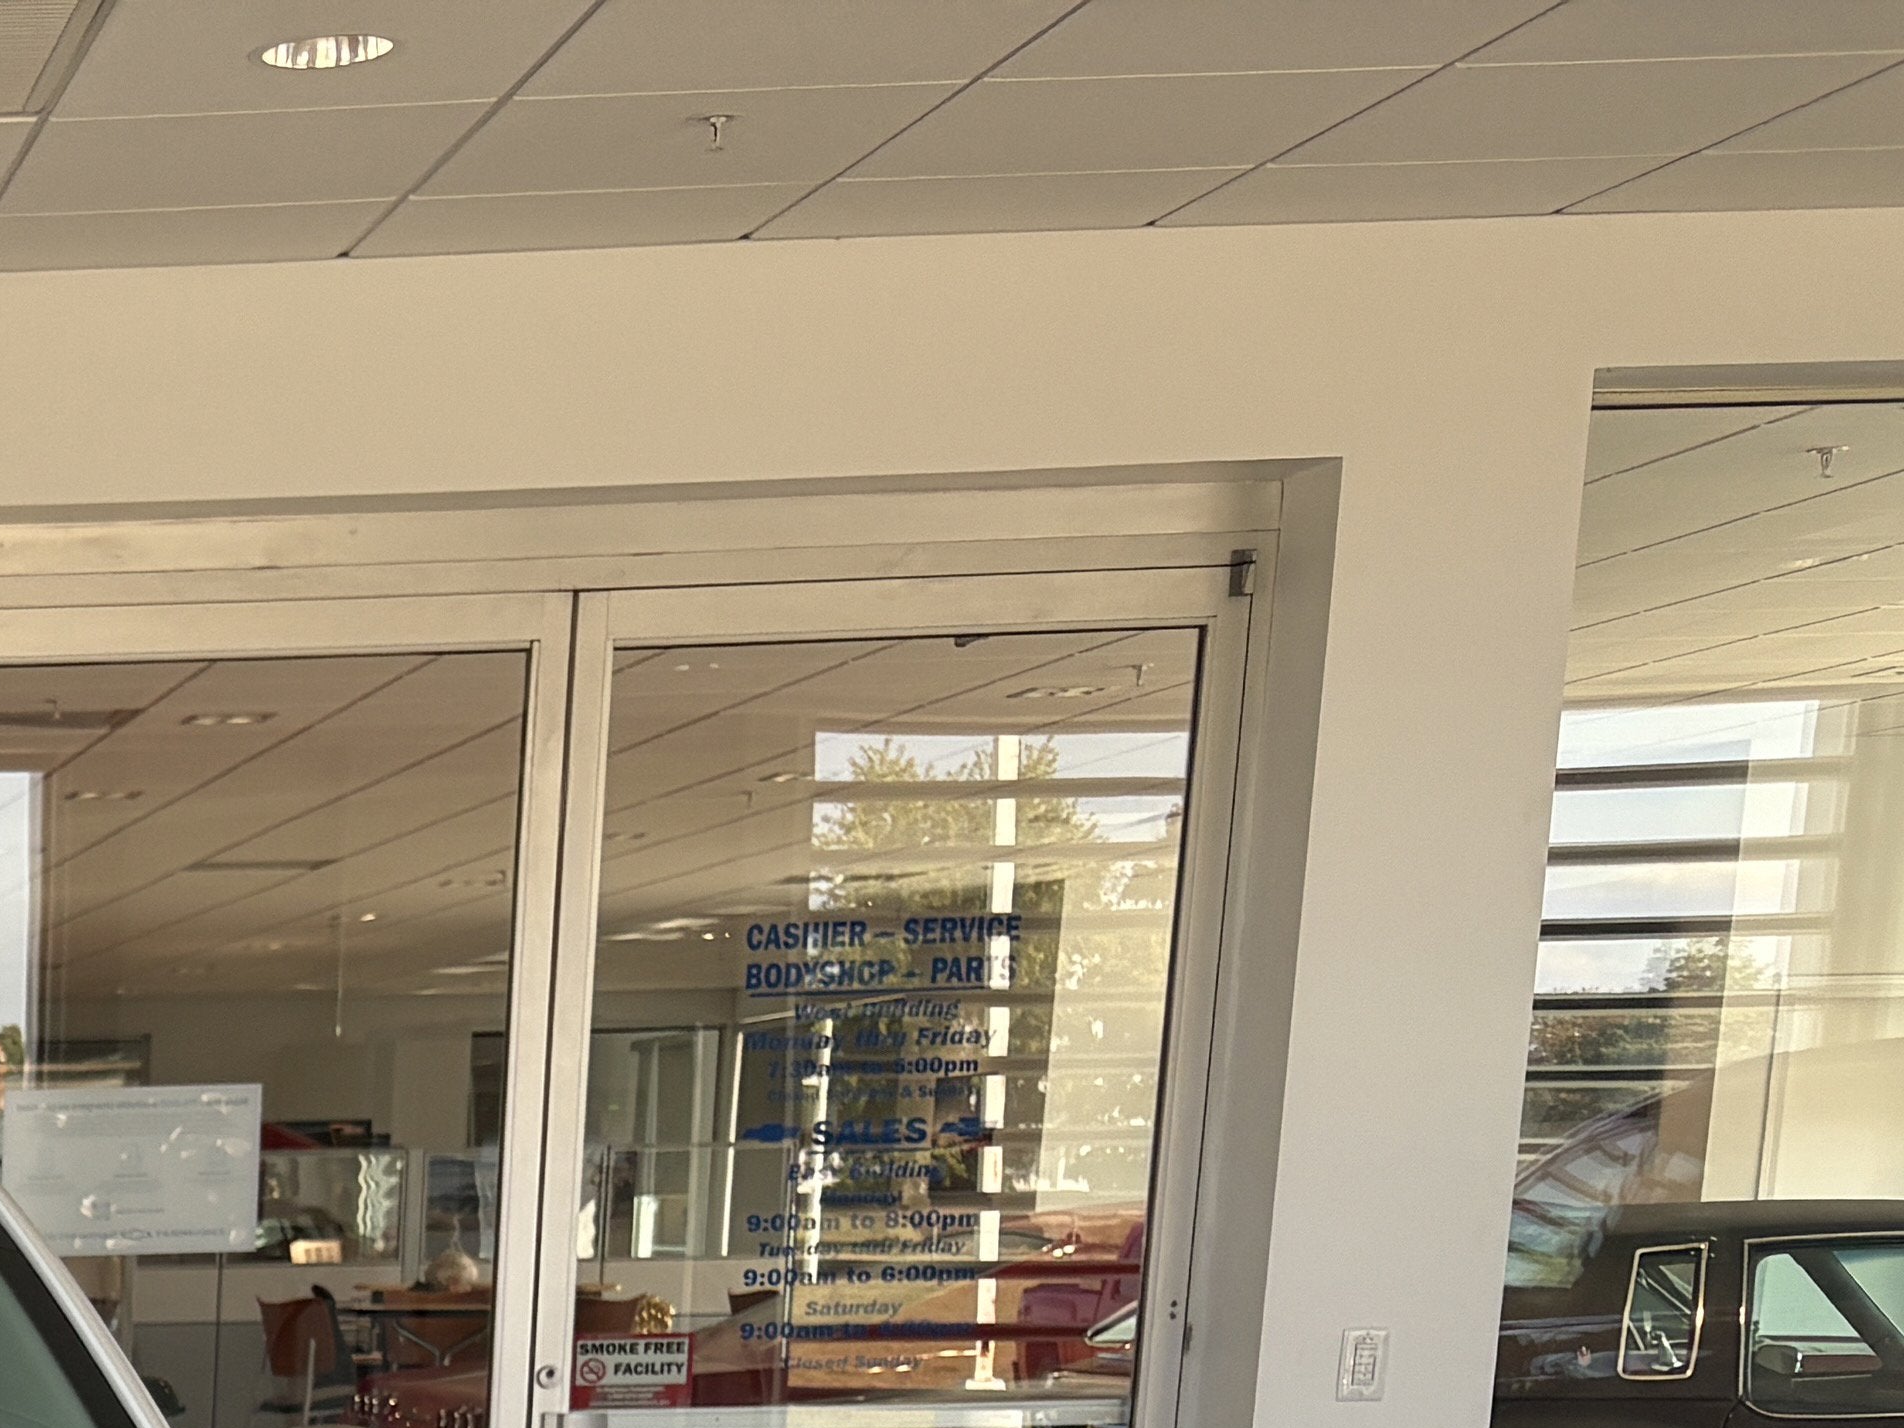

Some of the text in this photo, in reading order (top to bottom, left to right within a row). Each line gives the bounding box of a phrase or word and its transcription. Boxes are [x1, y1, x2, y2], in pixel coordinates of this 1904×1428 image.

[746, 920, 868, 951] CASHIER
[902, 915, 1022, 946] SERVICE
[745, 959, 896, 991] BODYSHOP
[916, 1025, 997, 1049] Friday
[894, 1057, 980, 1078] 5:00pm
[811, 1116, 928, 1146] SALES
[746, 1209, 978, 1233] 9:00am to 8:00pm
[742, 1264, 977, 1288] 9:00am to 6:00pm
[803, 1299, 905, 1318] Saturday
[578, 1340, 686, 1356] SMOKE FREE
[613, 1361, 685, 1376] FACILITY
